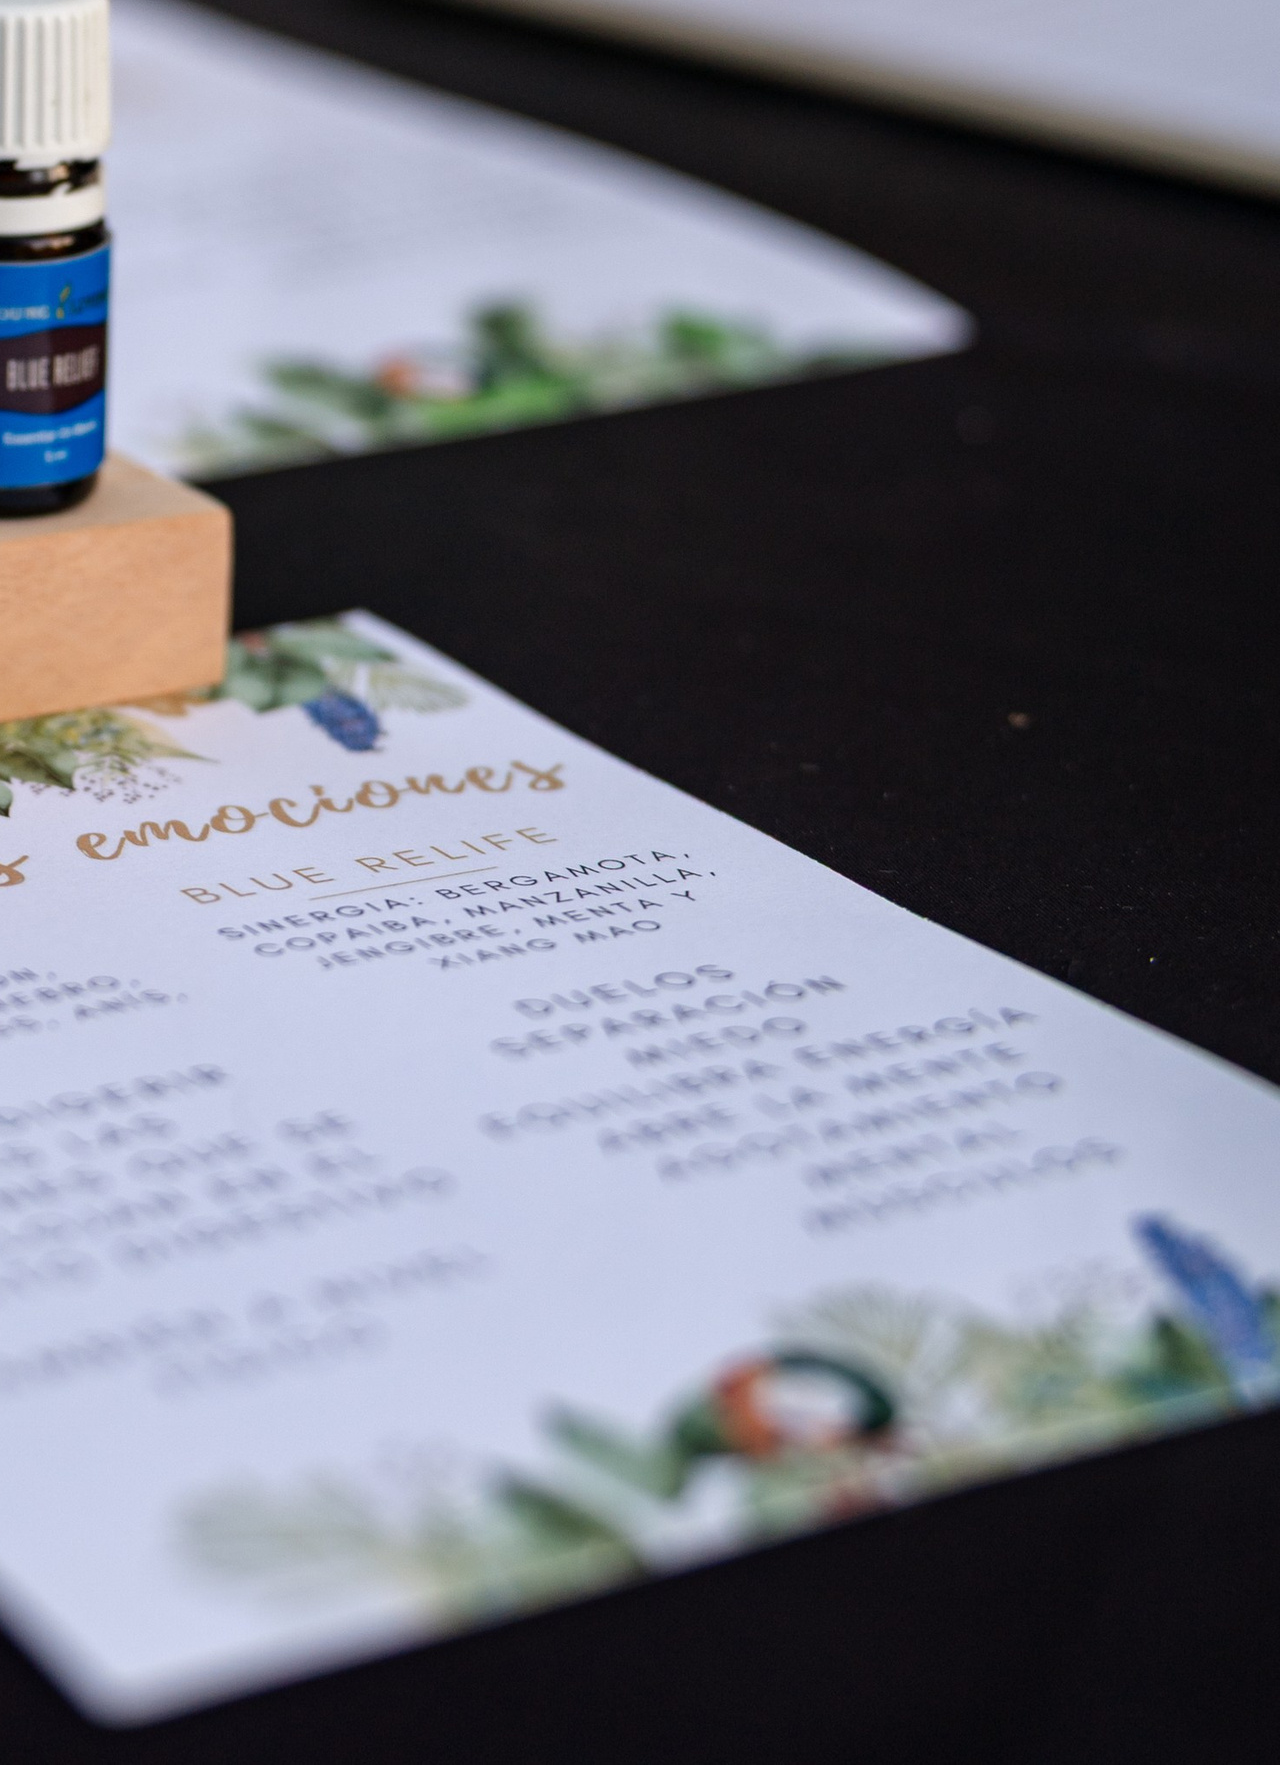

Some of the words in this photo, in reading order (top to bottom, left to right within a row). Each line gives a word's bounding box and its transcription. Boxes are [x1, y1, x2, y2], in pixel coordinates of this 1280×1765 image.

[6, 356, 49, 392] BLUE
[75, 757, 570, 864] emociones
[180, 866, 335, 904] BLUE
[354, 827, 558, 873] RELIFE
[217, 896, 423, 941] SINERGIA:
[434, 850, 690, 900] BERGAMOTA,
[253, 915, 451, 957] COPAIBA,
[463, 867, 716, 918] MANZANILLA,
[316, 924, 522, 970] JENGIBRE,
[532, 898, 664, 928] MENTA
[670, 889, 696, 902] Y
[427, 937, 557, 971] XIANG
[571, 919, 662, 945] MAO
[487, 975, 848, 1061] SEPARACIÓN
[512, 963, 735, 1020] DUELOS
[625, 1015, 808, 1071] MIEDO
